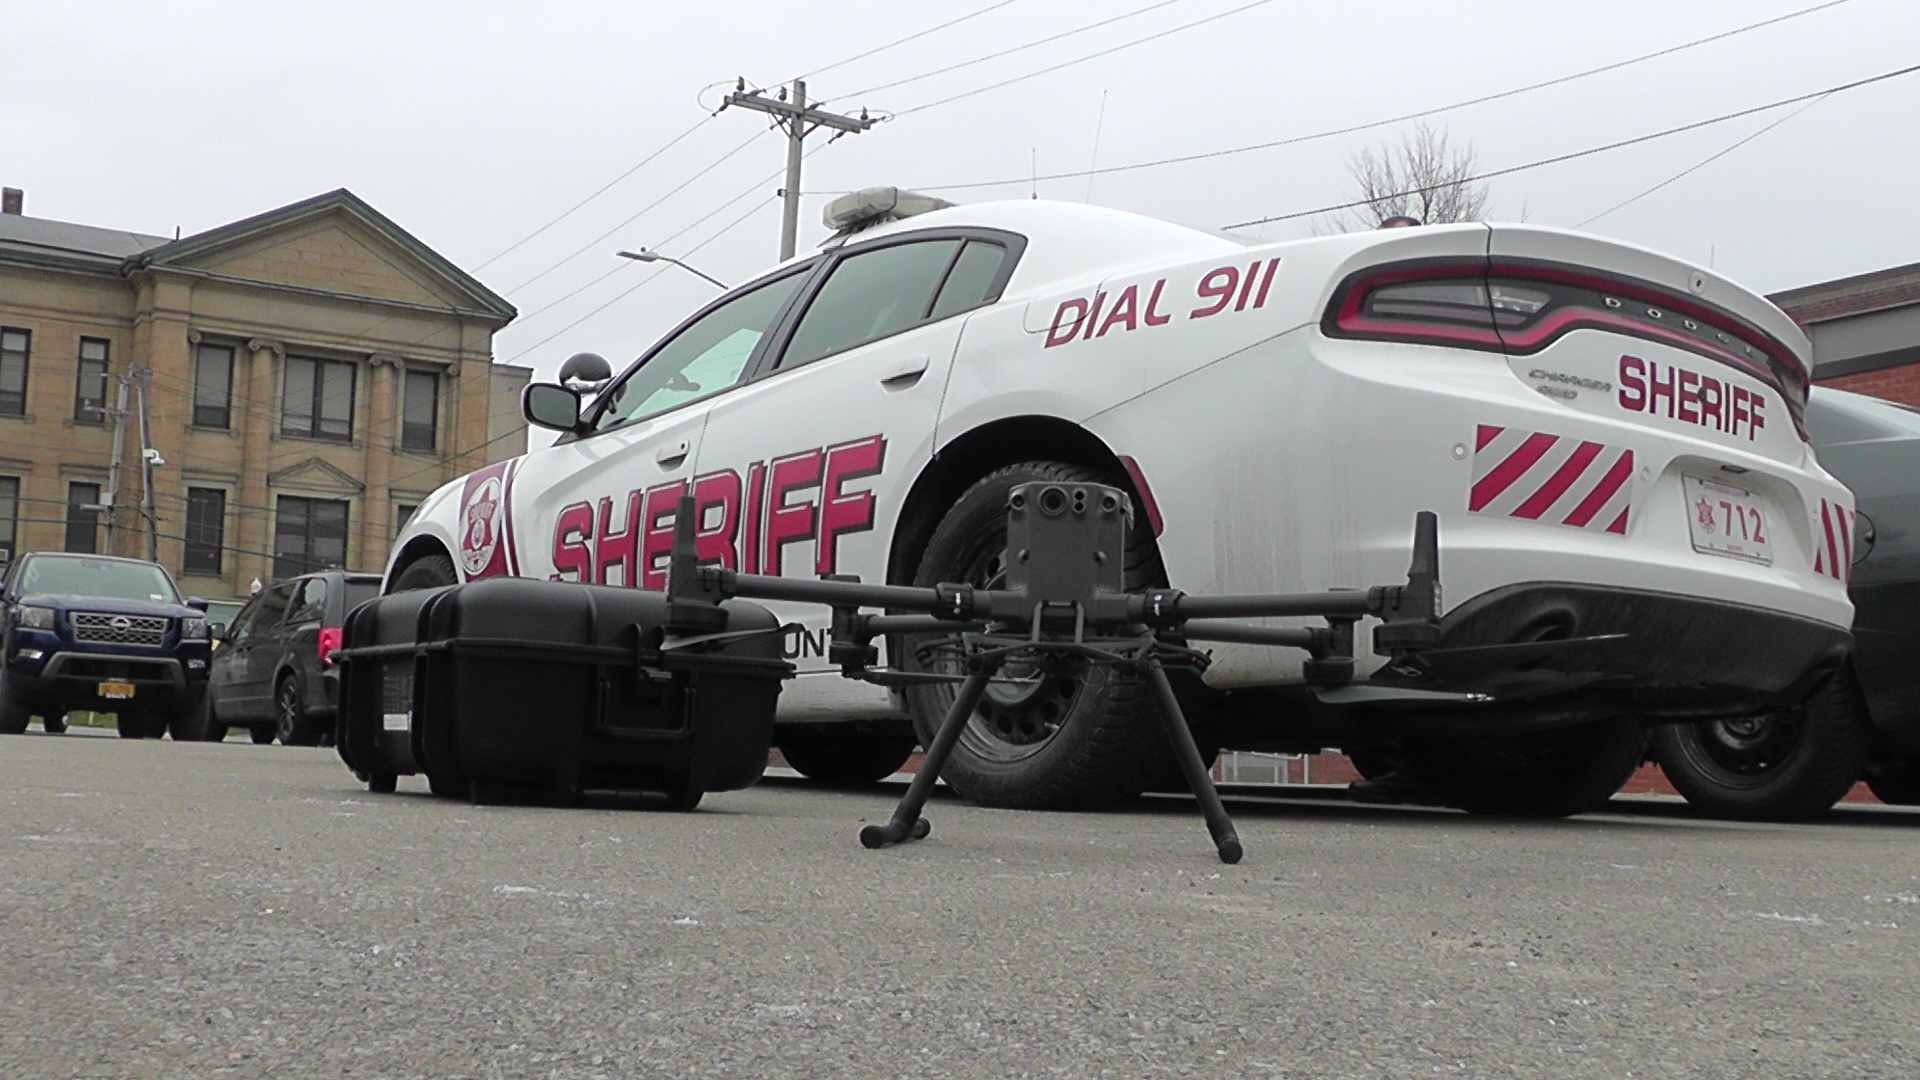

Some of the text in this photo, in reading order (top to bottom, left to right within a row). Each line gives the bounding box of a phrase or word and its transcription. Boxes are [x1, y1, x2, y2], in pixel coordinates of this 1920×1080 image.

[1044, 257, 1281, 348] DIAL 911
[1619, 355, 1765, 441] SHERIFF
[550, 434, 887, 591] SHERIFF
[1719, 500, 1765, 544] 712
